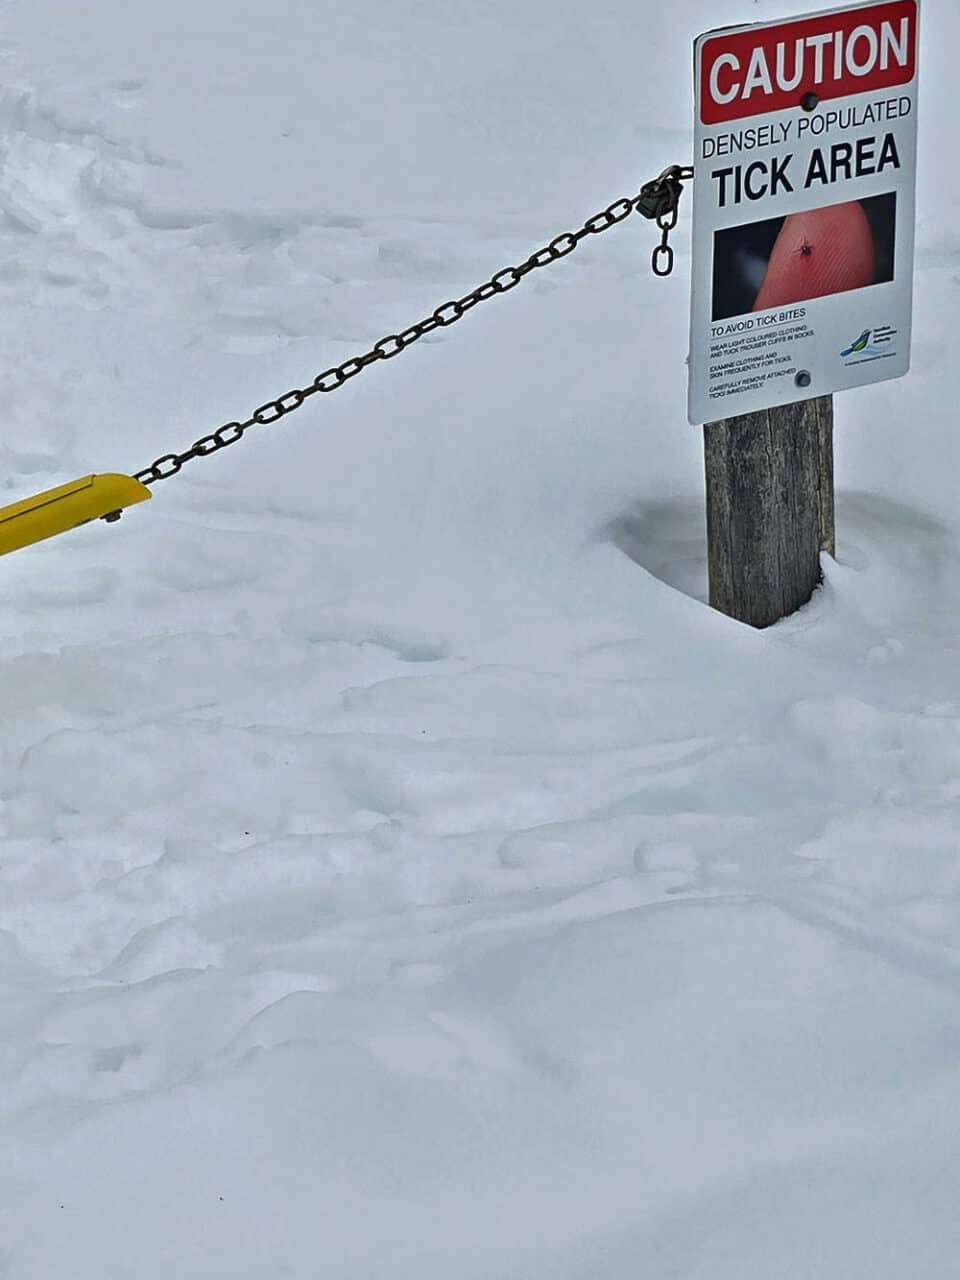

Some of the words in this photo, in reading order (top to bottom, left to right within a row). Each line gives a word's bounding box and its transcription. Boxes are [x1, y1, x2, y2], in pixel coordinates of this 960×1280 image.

[709, 17, 909, 104] CAUTION
[702, 120, 792, 159] DENSELY
[798, 96, 911, 138] POPULATED
[712, 154, 793, 207] TICK
[804, 133, 900, 188] AREA
[712, 326, 724, 337] TO
[725, 320, 754, 334] AVOID
[756, 313, 778, 326] TICK
[779, 308, 806, 321] BITES
[746, 331, 777, 344] COLOURED
[710, 350, 723, 359] AND
